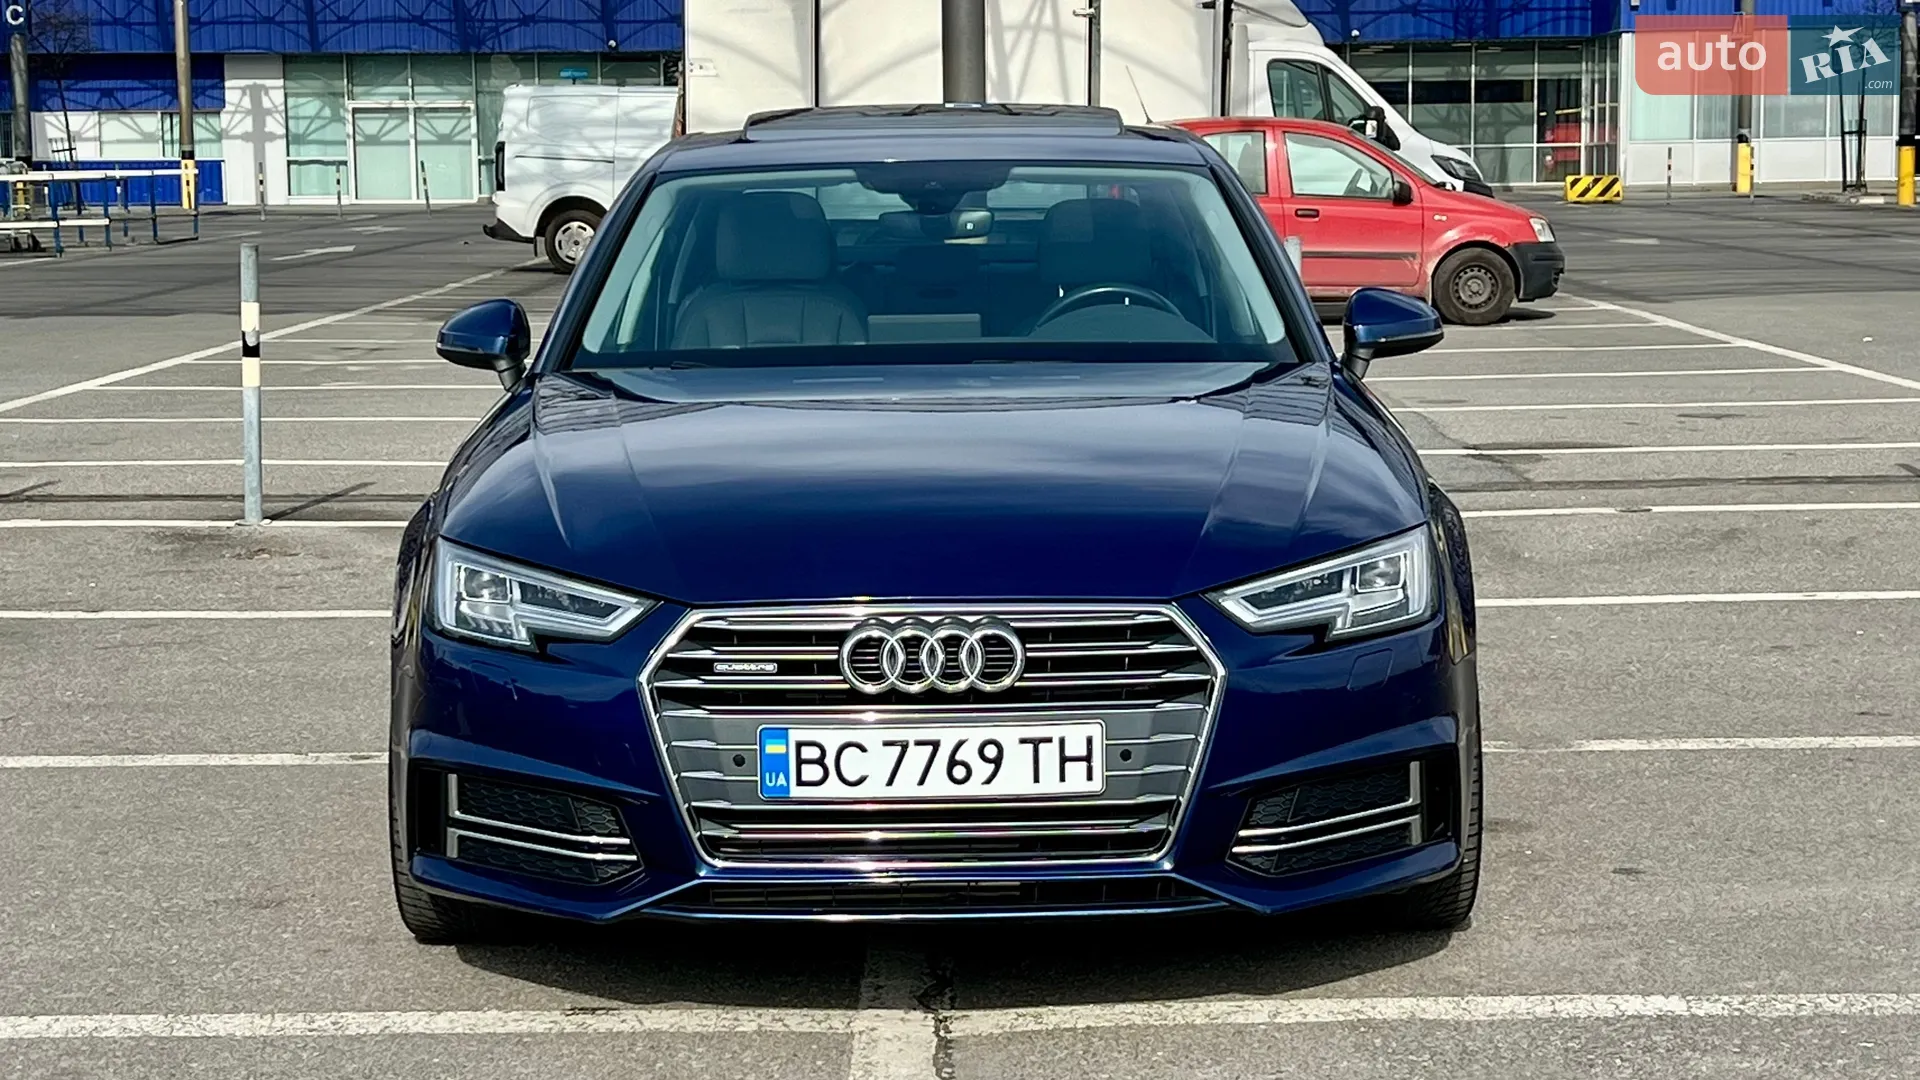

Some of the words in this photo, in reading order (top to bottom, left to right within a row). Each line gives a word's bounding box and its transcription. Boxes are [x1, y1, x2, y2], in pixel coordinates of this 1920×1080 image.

[6, 4, 25, 25] C
[795, 740, 870, 787] BC
[882, 738, 1004, 786] 7769
[1018, 735, 1093, 784] TH
[765, 771, 788, 787] UA
